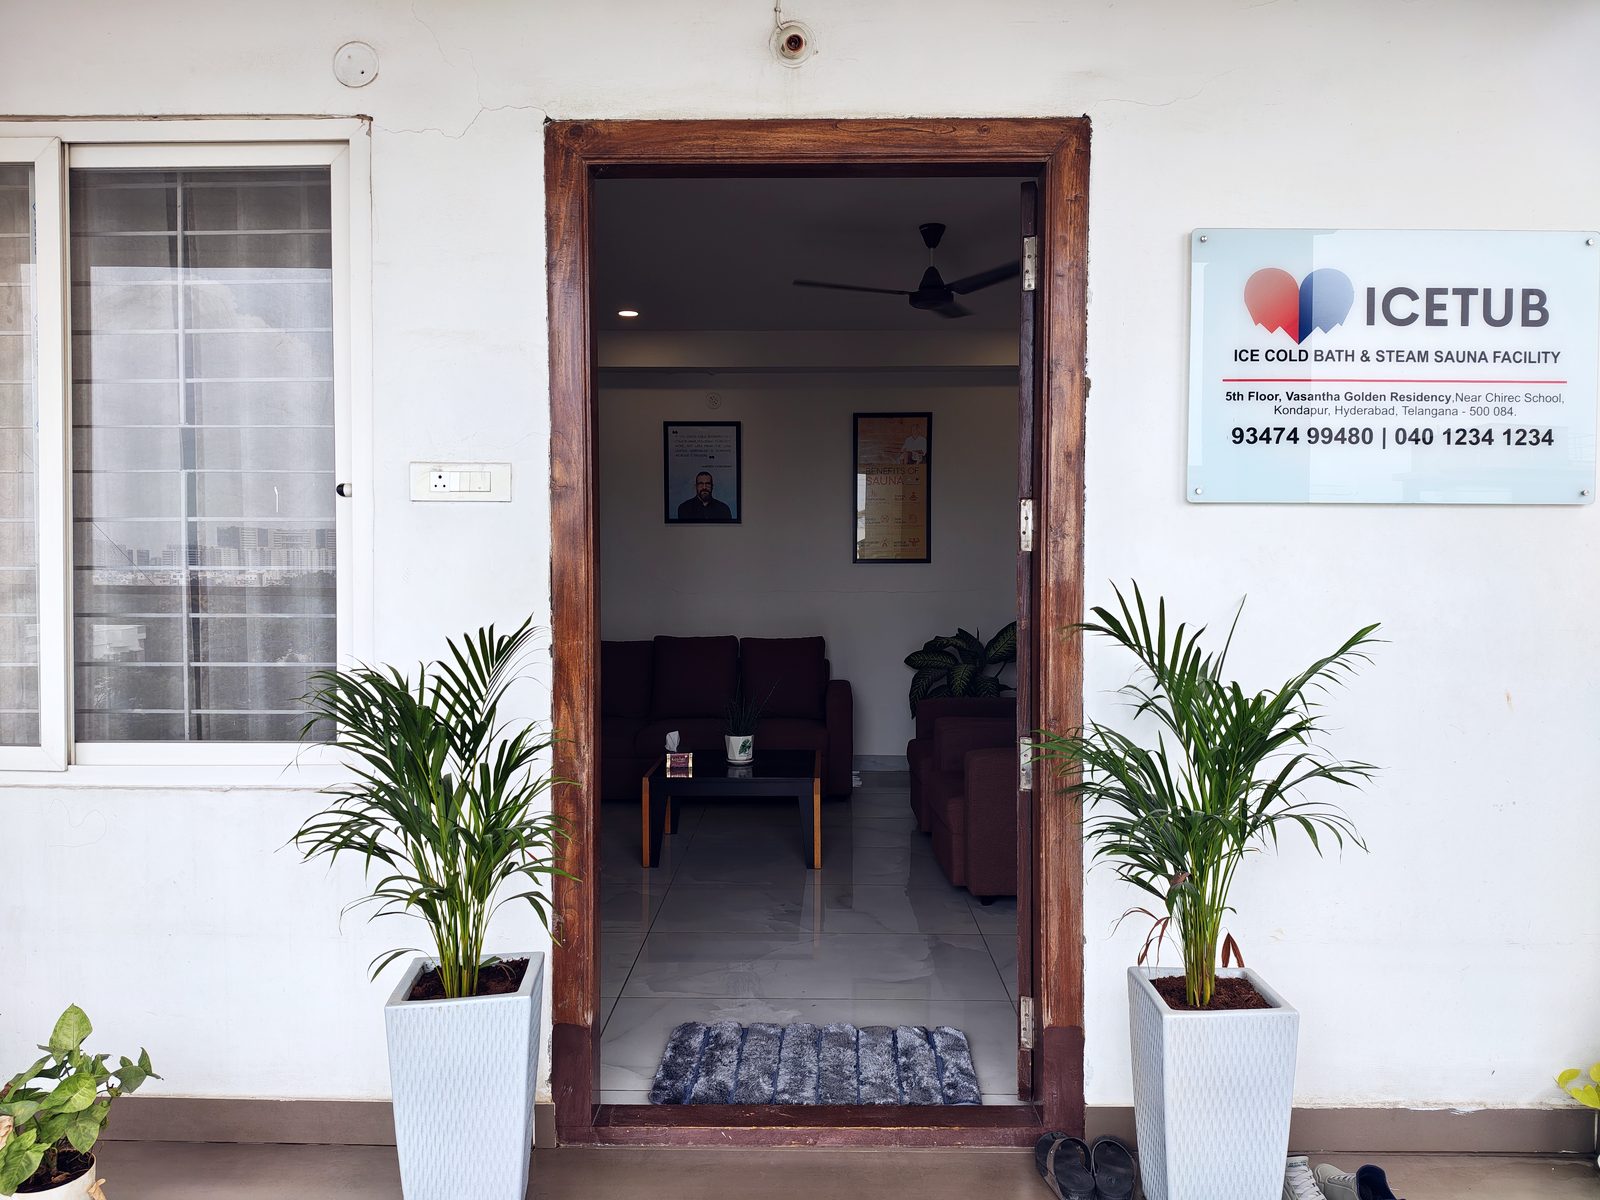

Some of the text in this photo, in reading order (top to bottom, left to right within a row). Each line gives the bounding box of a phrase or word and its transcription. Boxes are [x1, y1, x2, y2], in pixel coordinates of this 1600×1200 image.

[1366, 286, 1549, 327] ICETUB
[1234, 349, 1561, 364] ICE COLD BATH & STEAM SAUNA FACILITY
[1225, 391, 1244, 401] 5th
[1248, 391, 1282, 402] Floor,
[1286, 391, 1340, 401] Vasantha
[1344, 392, 1386, 402] Golden
[1485, 392, 1521, 403] Chirec
[1524, 392, 1565, 404] School,
[1274, 405, 1331, 417] Kondapur,
[1334, 405, 1398, 418] Hyderabad,
[1402, 406, 1458, 418] Telangana
[1469, 406, 1490, 416] 500
[1493, 406, 1517, 417] 084.
[1231, 427, 1299, 445] 93474
[1307, 427, 1373, 445] 99480
[1395, 428, 1434, 446] 040
[1442, 428, 1494, 446] 1234
[1502, 428, 1554, 446] 1234
[908, 466, 919, 474] OF
[866, 475, 905, 486] SAUNA
